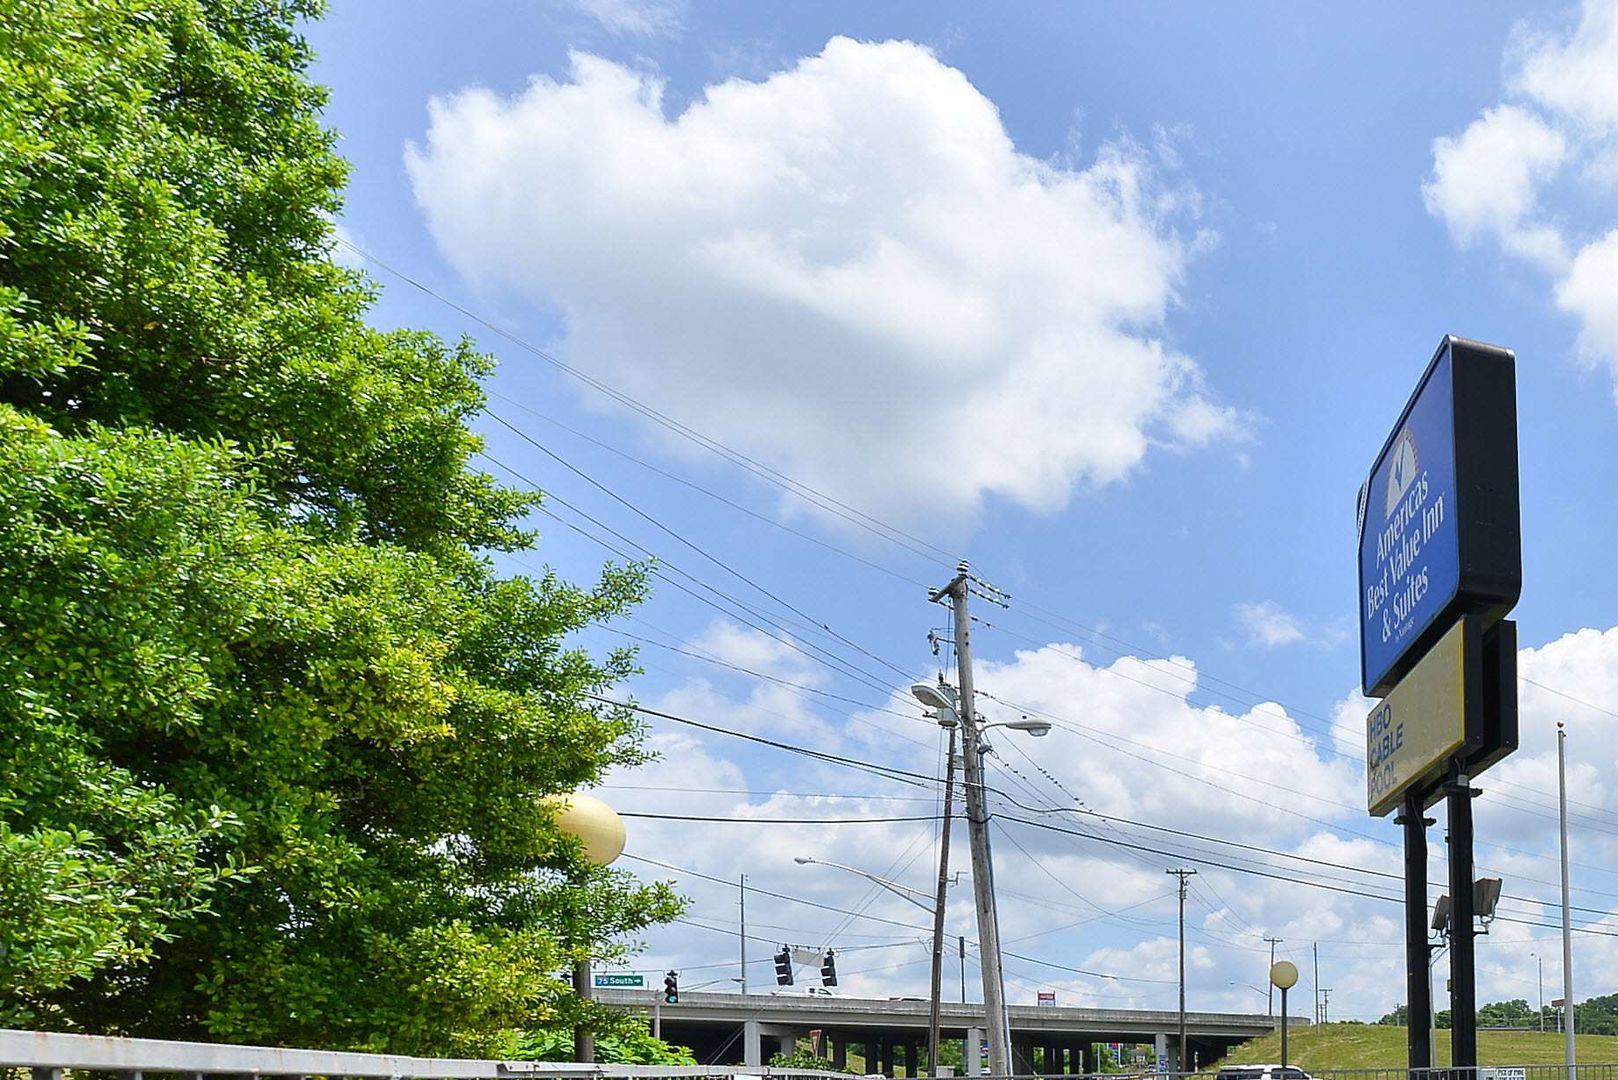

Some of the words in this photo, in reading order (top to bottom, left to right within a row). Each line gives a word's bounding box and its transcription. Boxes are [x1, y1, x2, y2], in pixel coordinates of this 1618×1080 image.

[1377, 471, 1429, 569] Americas
[1367, 571, 1389, 620] Best
[1389, 528, 1420, 587] Value
[1423, 495, 1444, 546] Inn
[1382, 607, 1392, 644] &
[1393, 565, 1429, 630] Suites
[1369, 703, 1392, 744] HBO
[1370, 722, 1404, 769] CABLE
[1368, 761, 1397, 802] POOL
[610, 977, 634, 985] South
